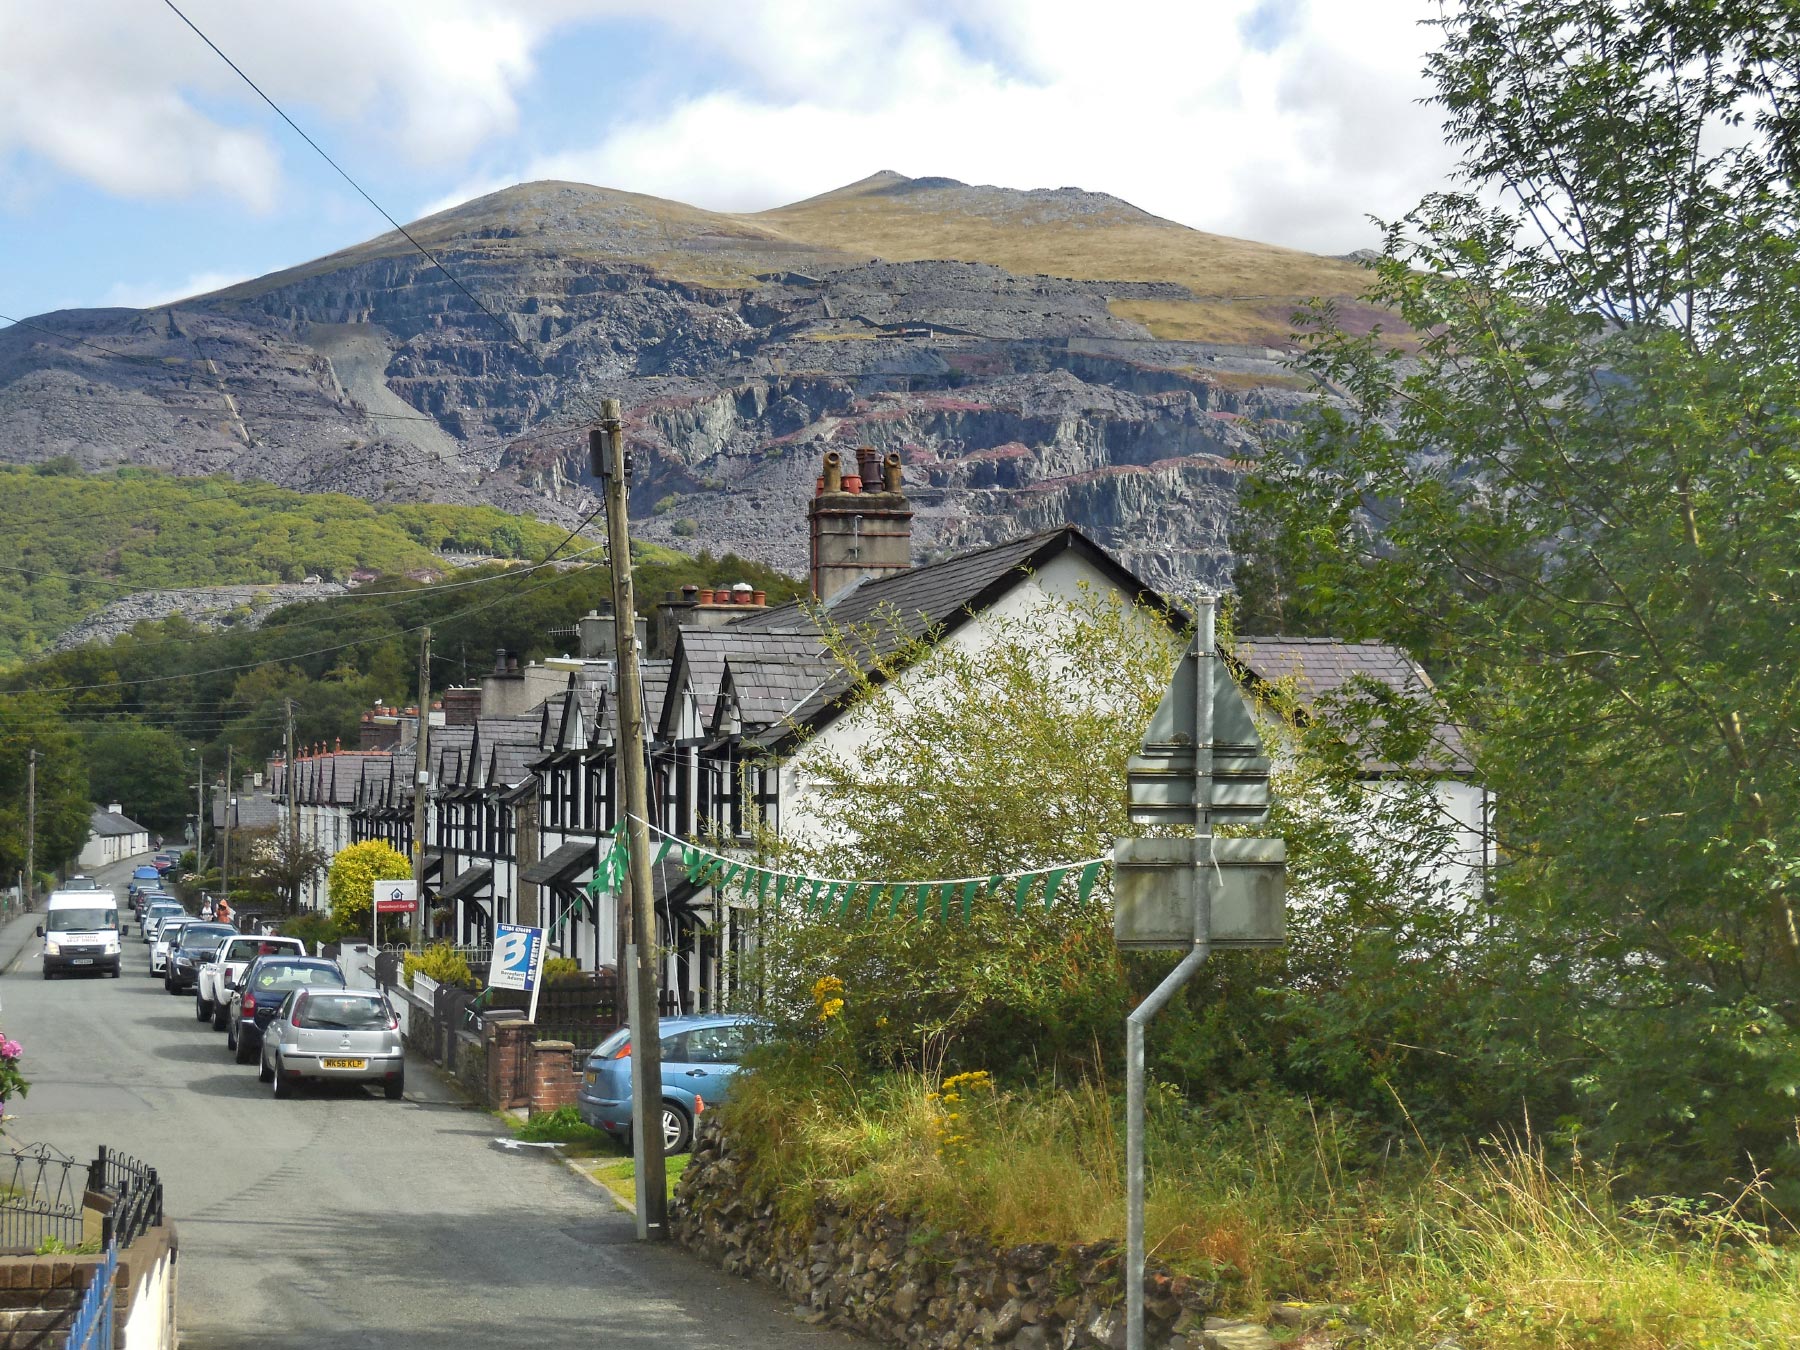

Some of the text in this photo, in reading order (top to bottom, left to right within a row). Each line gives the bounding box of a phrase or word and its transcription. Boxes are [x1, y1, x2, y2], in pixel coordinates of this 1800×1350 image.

[527, 936, 541, 982] AR WERTH
[348, 1060, 362, 1068] KLP
